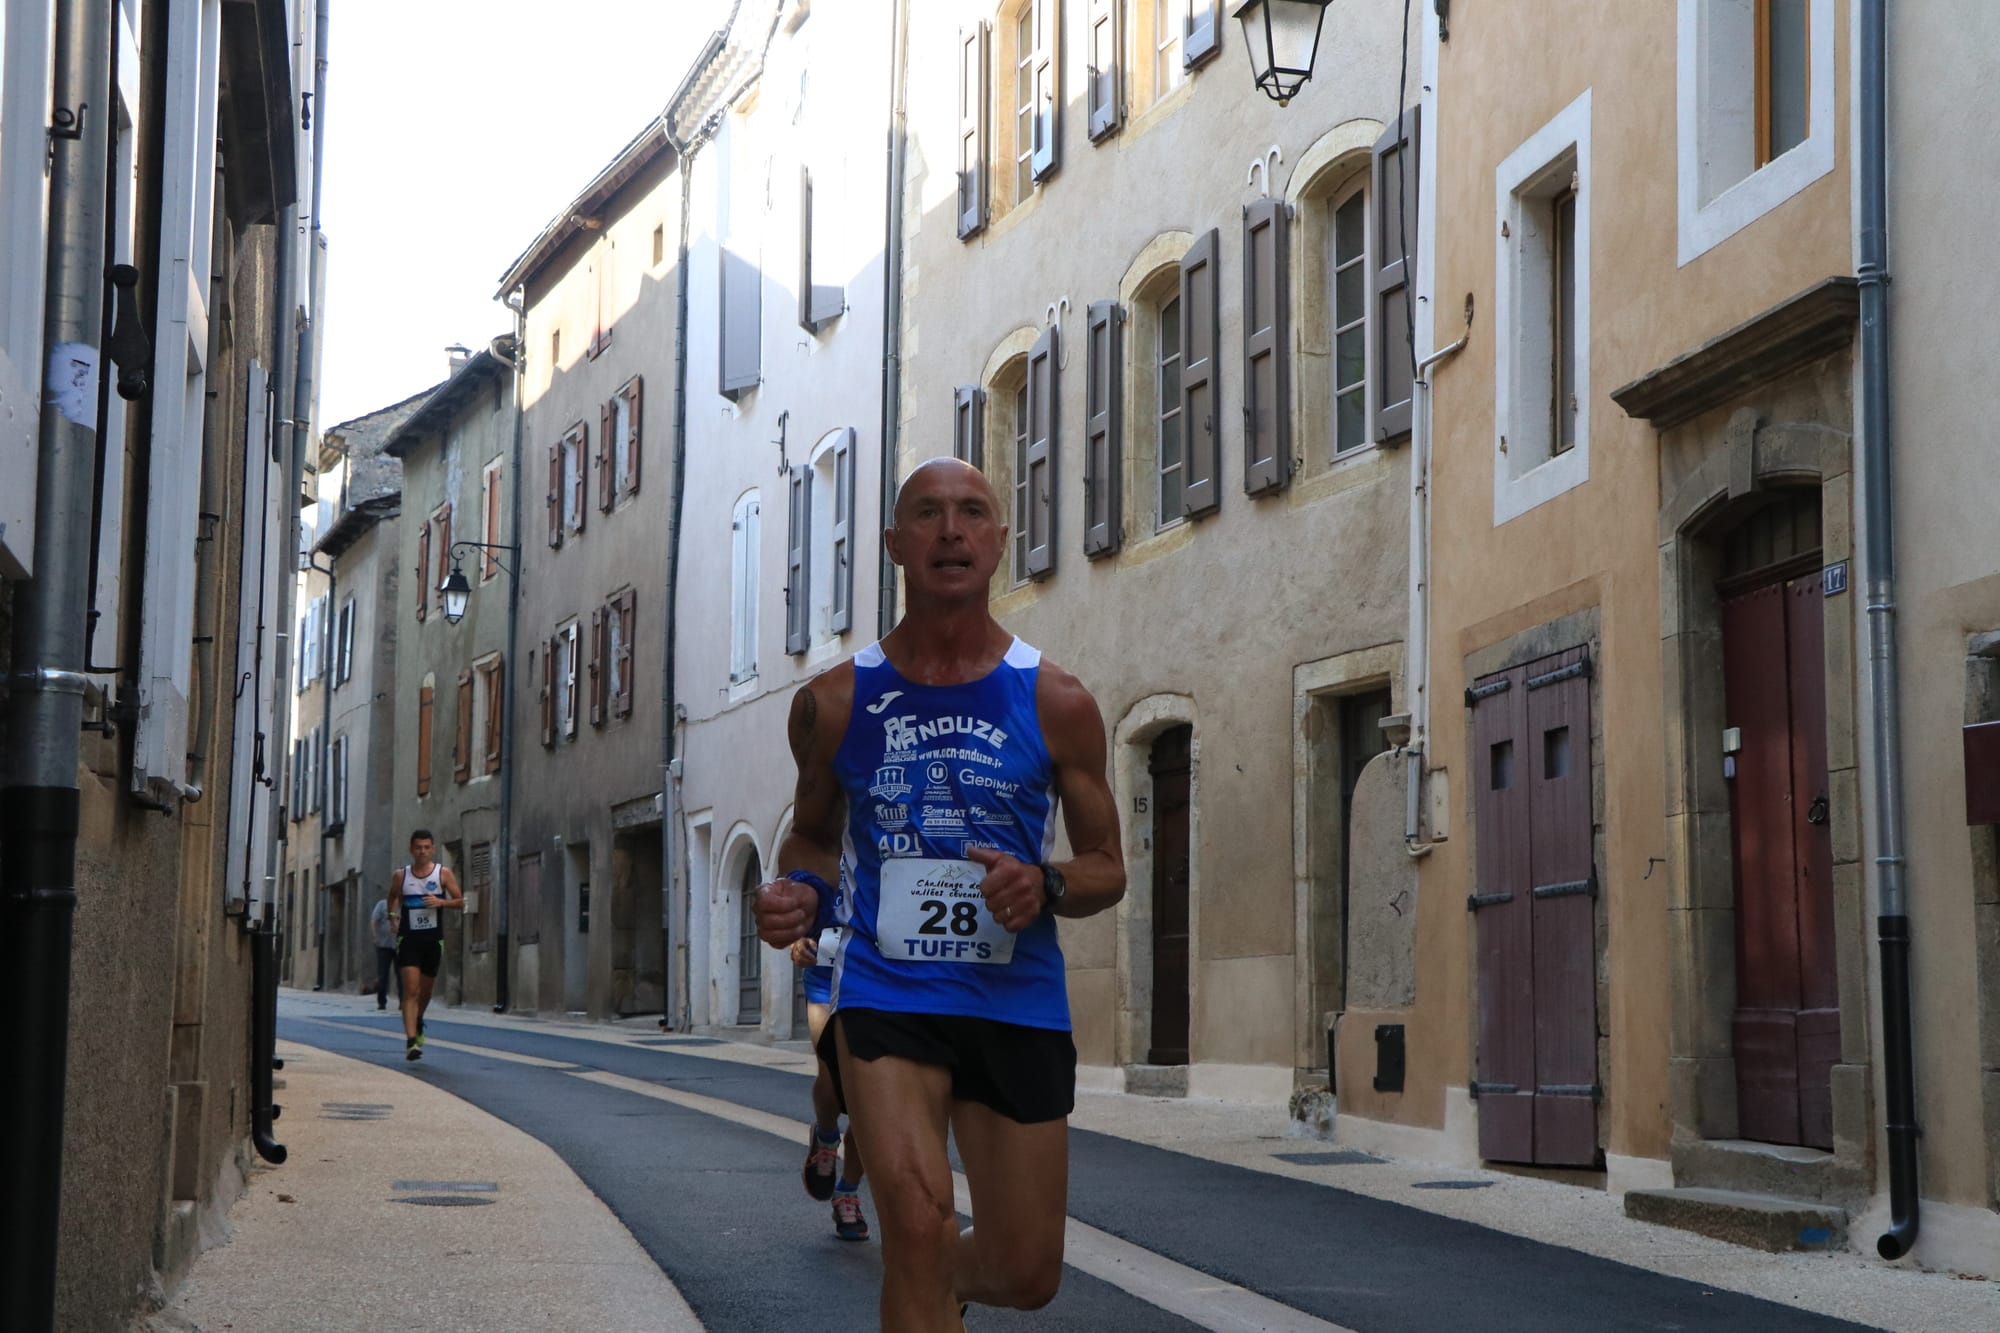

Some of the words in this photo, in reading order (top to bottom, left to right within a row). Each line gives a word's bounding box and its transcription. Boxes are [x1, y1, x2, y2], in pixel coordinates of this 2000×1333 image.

[1827, 568, 1842, 590] 17
[918, 747, 1003, 769] www.acn-anduze.fr
[945, 809, 967, 818] BAT
[1133, 797, 1148, 813] 15
[916, 879, 963, 890] Challenge
[417, 916, 429, 924] 95
[918, 900, 978, 937] 28
[904, 939, 991, 960] TUFF'S
